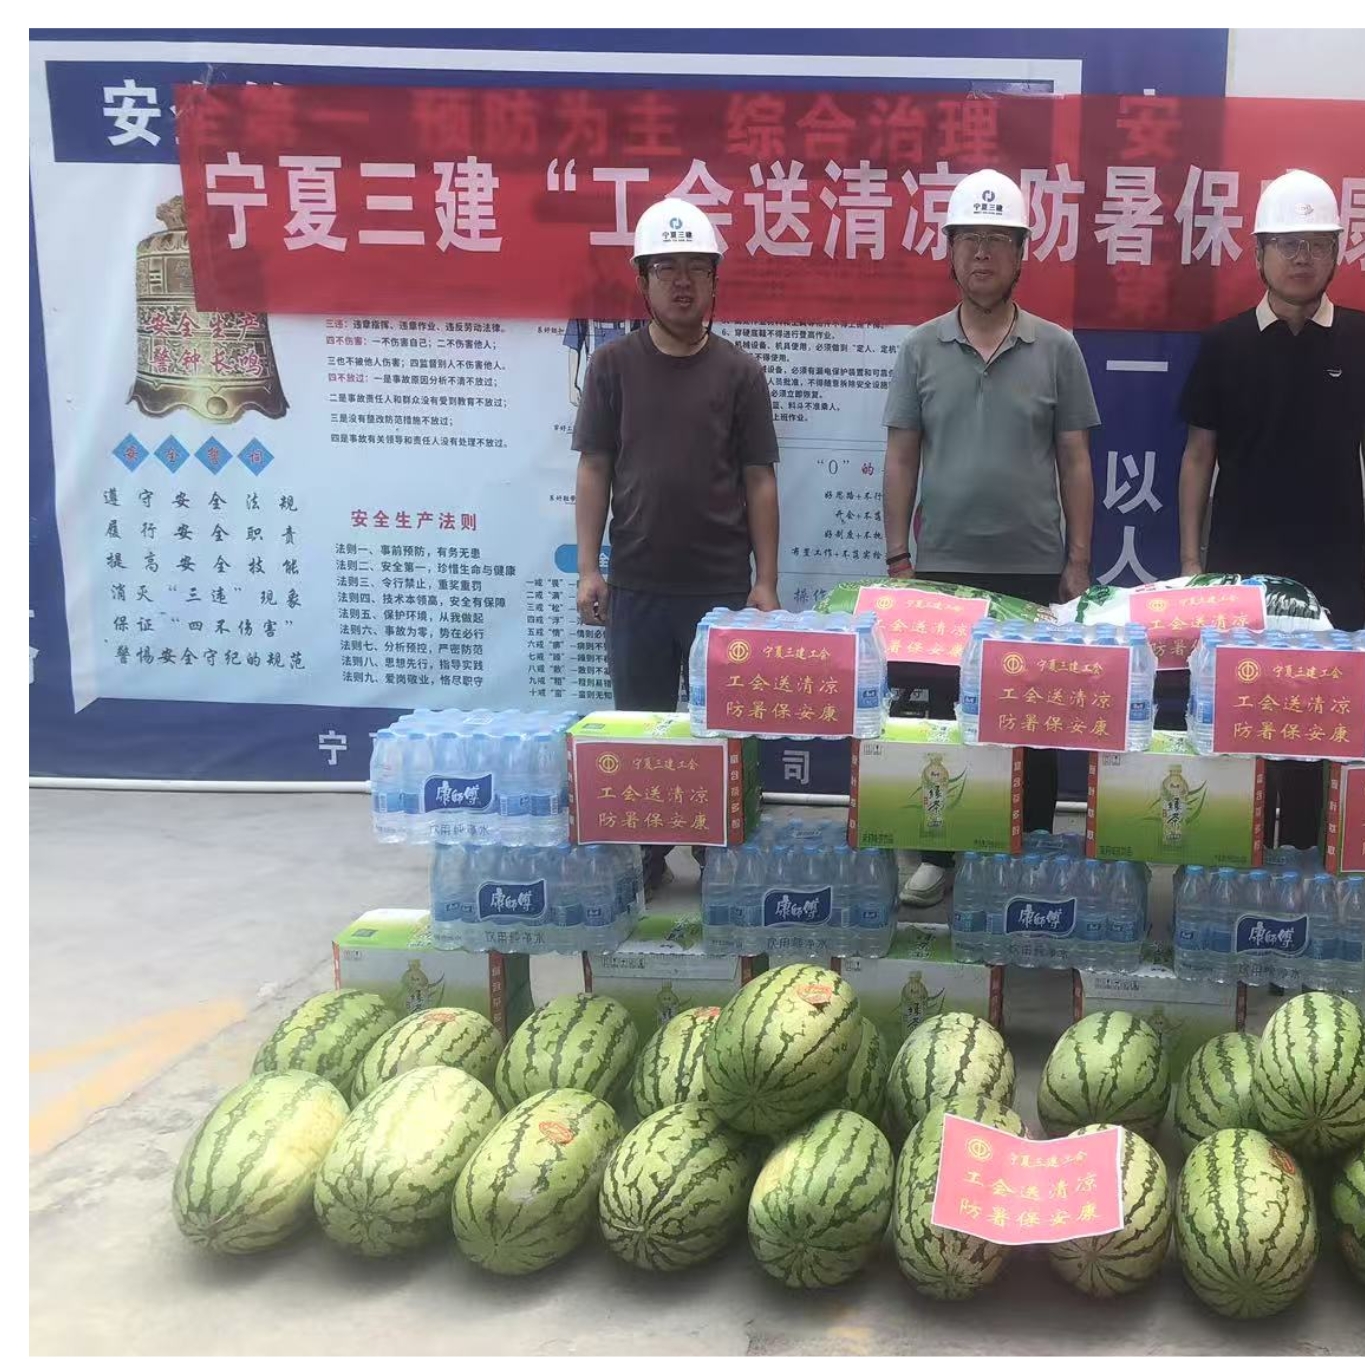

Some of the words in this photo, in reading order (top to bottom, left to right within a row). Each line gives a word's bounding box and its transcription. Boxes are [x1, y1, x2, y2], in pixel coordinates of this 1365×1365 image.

[205, 152, 501, 253] 宁夏三建
[148, 311, 260, 338] 安全生产
[148, 349, 266, 377] 警钟长鸣
[103, 487, 298, 512] 遵守安全法规
[106, 519, 298, 545] 履行安全职责
[351, 510, 478, 531] 安全生产法则
[106, 551, 300, 575] 提高安全技能
[762, 645, 831, 661] 宁夏三建工会
[1036, 659, 1104, 676] 宁夏三建工会
[1272, 664, 1343, 681] 宁夏三建工会
[726, 673, 840, 696] 工会送清凉
[999, 686, 1113, 710] 工会送清凉
[1233, 693, 1352, 715] 工会送清凉
[725, 701, 839, 723] 防暑保安康
[997, 712, 1110, 737] 防暑保安康
[1233, 722, 1352, 744] 防暑保安康
[632, 754, 699, 771] 宁夏三建工会
[782, 750, 811, 784] 司
[597, 784, 709, 804] 工会送清凉
[597, 811, 710, 832] 防暑保安康
[963, 1170, 1098, 1201] 工会送清凉
[959, 1198, 1099, 1228] 防暑保安康
